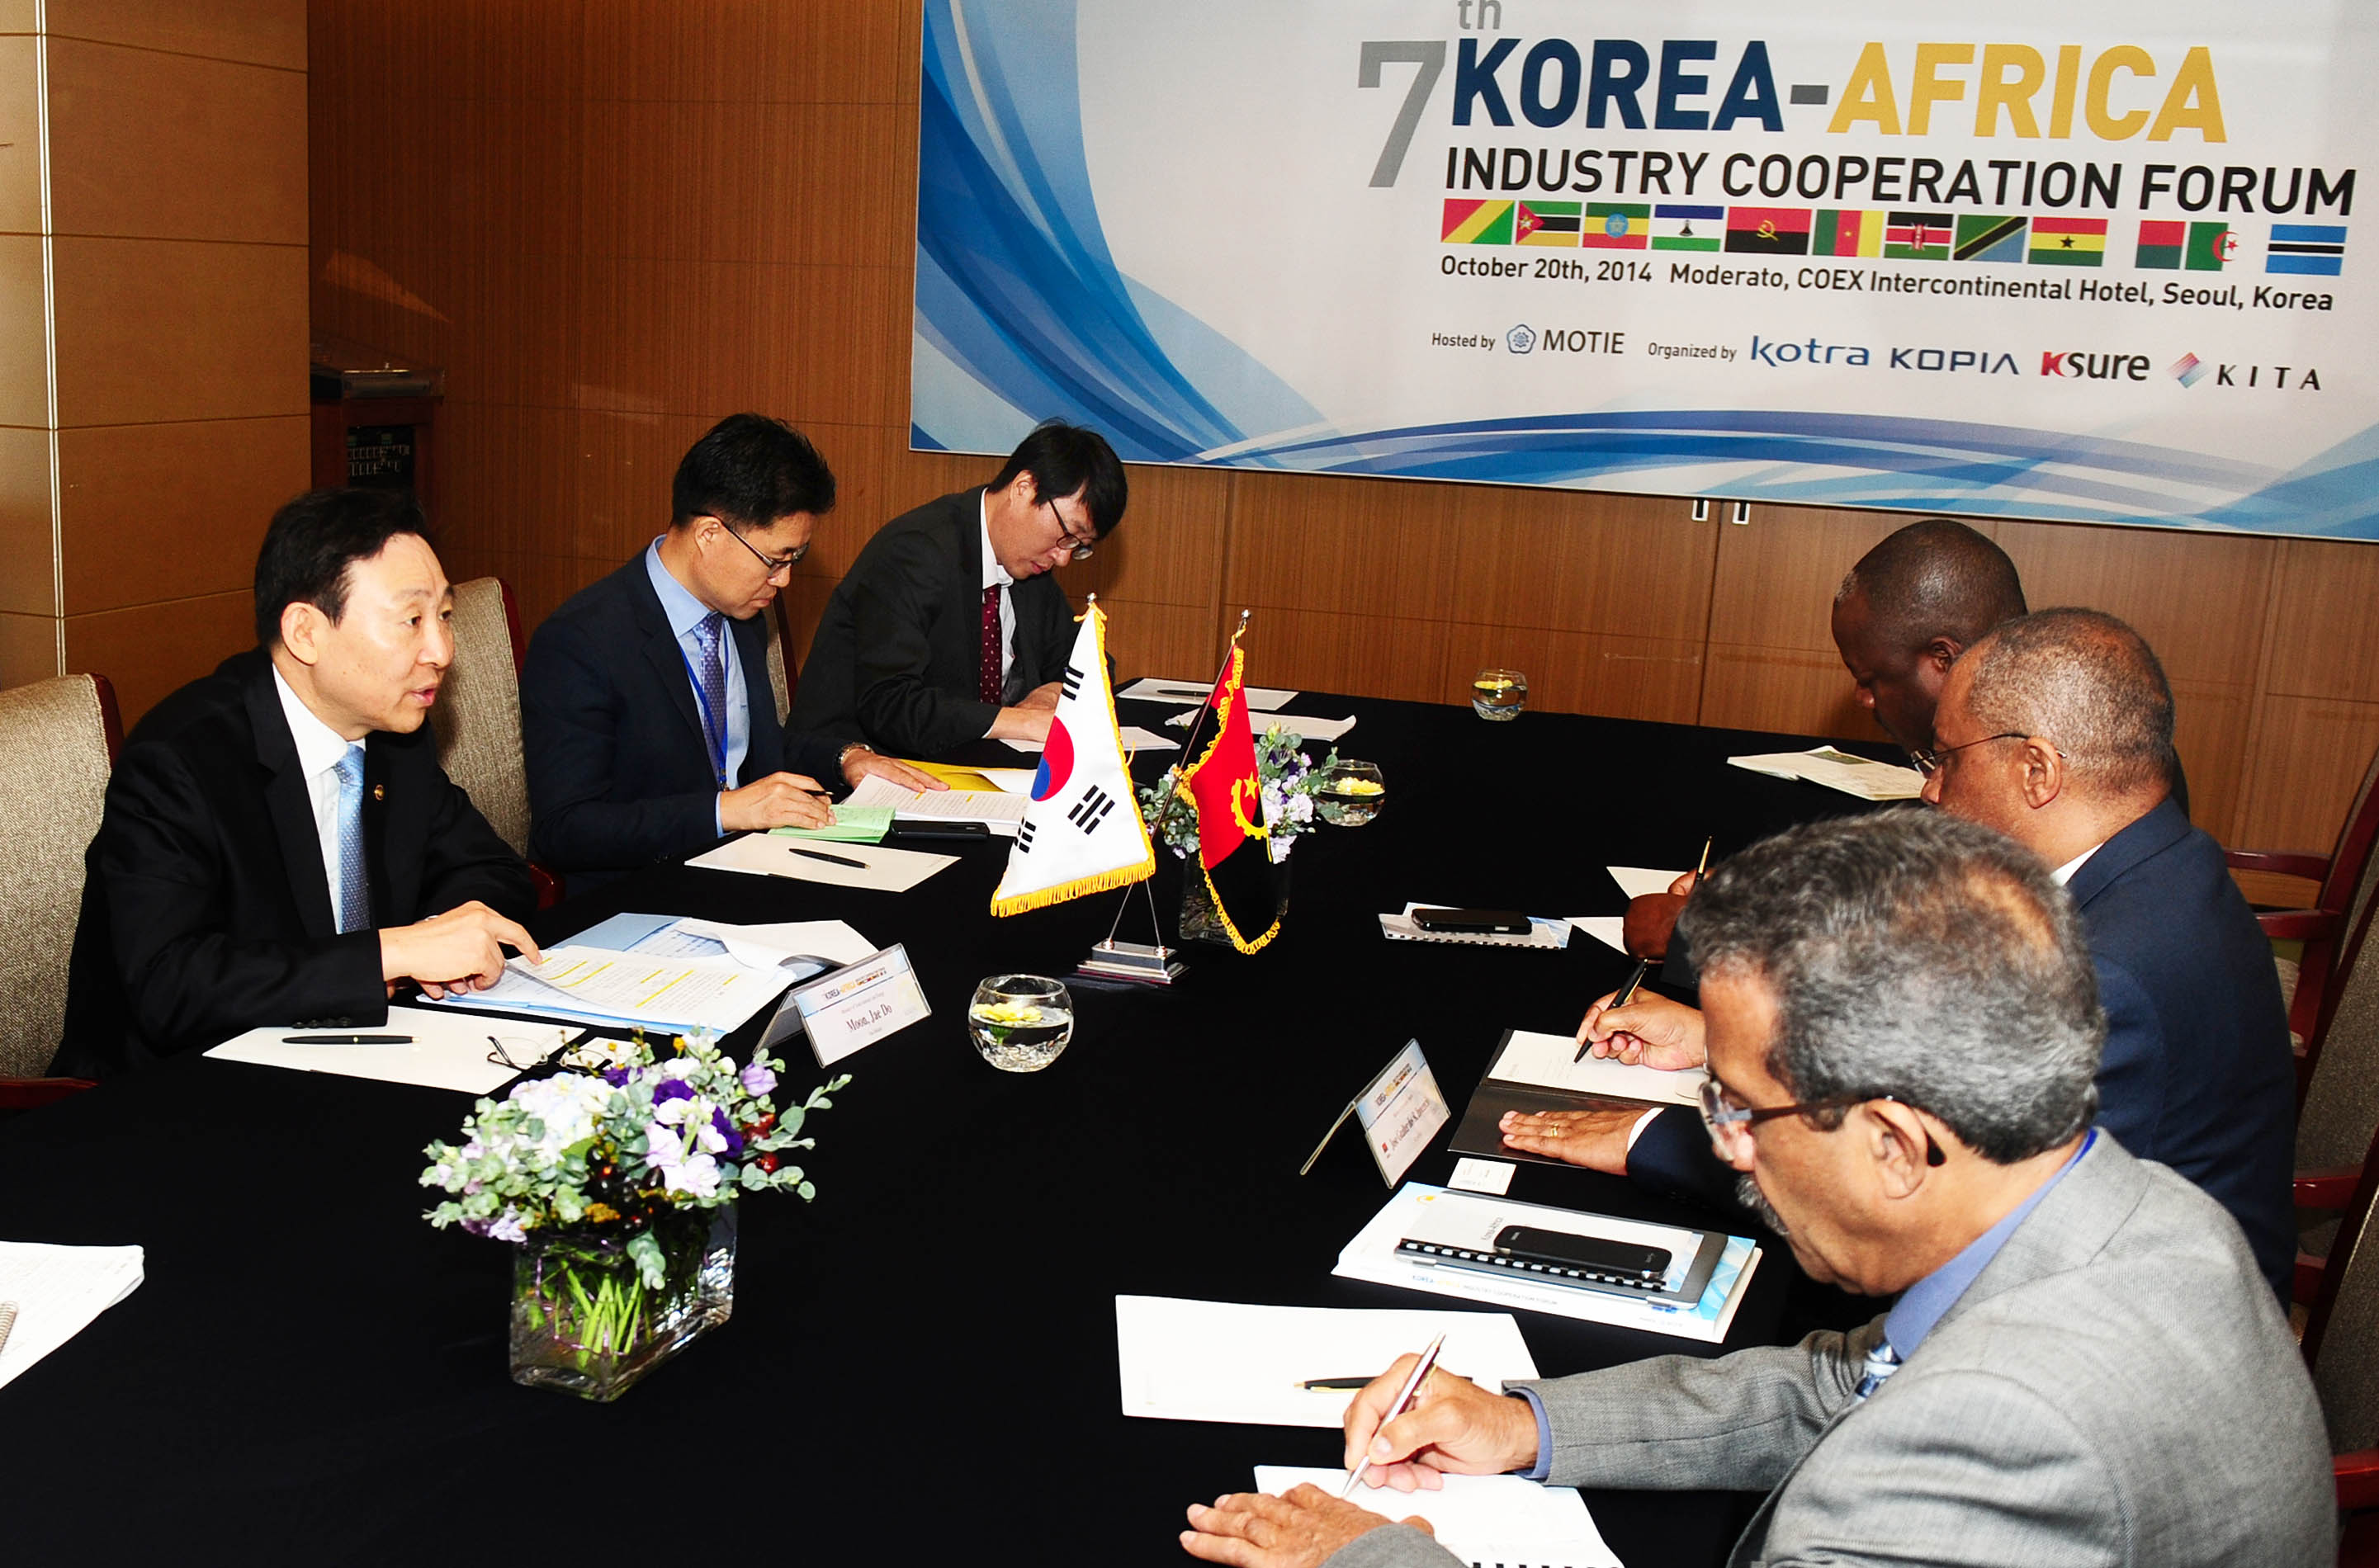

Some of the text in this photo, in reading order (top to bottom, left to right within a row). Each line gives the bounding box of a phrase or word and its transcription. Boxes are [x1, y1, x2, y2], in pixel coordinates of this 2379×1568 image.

[1358, 0, 1501, 187] 7 th
[1451, 38, 2227, 143] KOREA-AFRICA
[1445, 147, 2357, 217] INDUSTRY COOPERATION FORUM
[1440, 255, 2334, 312] October 20th, 2014 Moderato, COEX Intercontinental Hotel, Seoul, Korea
[1431, 332, 1496, 352] Hosted by
[1542, 329, 1625, 354] MOTIE
[1648, 342, 1738, 364] Organized by
[1750, 334, 1870, 366] kotra
[1889, 347, 2020, 375] KOPIA
[2216, 364, 2322, 391] KITA
